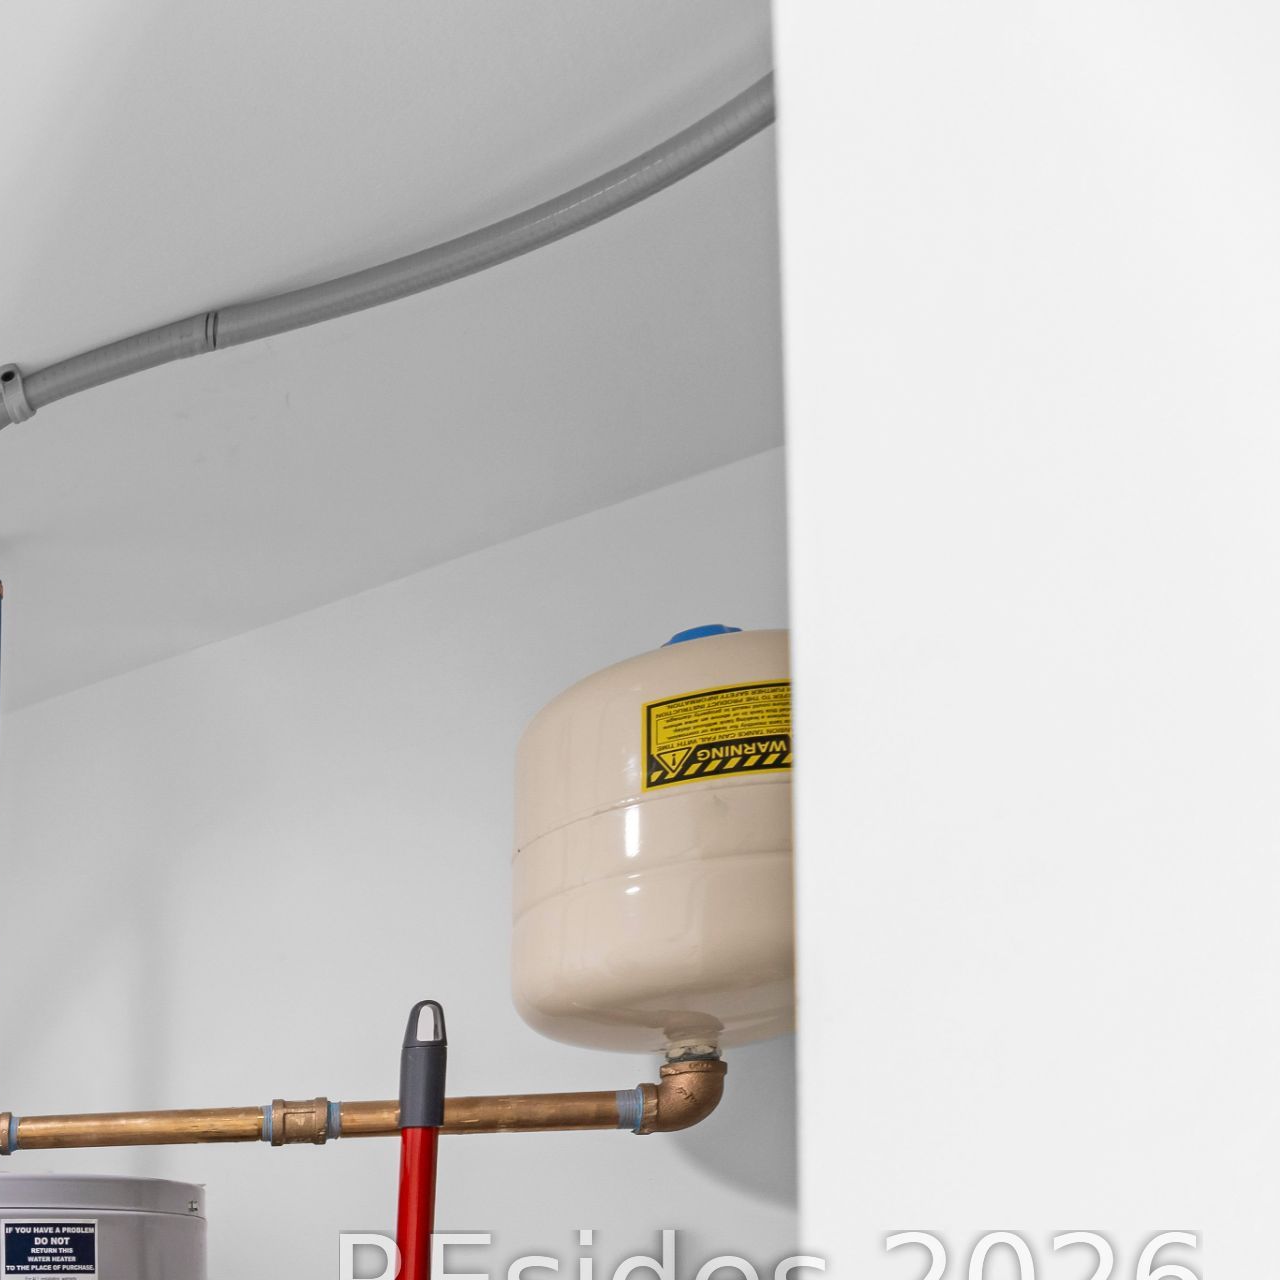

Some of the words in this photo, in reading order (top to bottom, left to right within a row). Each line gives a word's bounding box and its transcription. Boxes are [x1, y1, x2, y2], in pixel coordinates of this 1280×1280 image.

[697, 740, 787, 761] WARNING
[34, 1237, 48, 1245] DO
[50, 1237, 70, 1245] NOT
